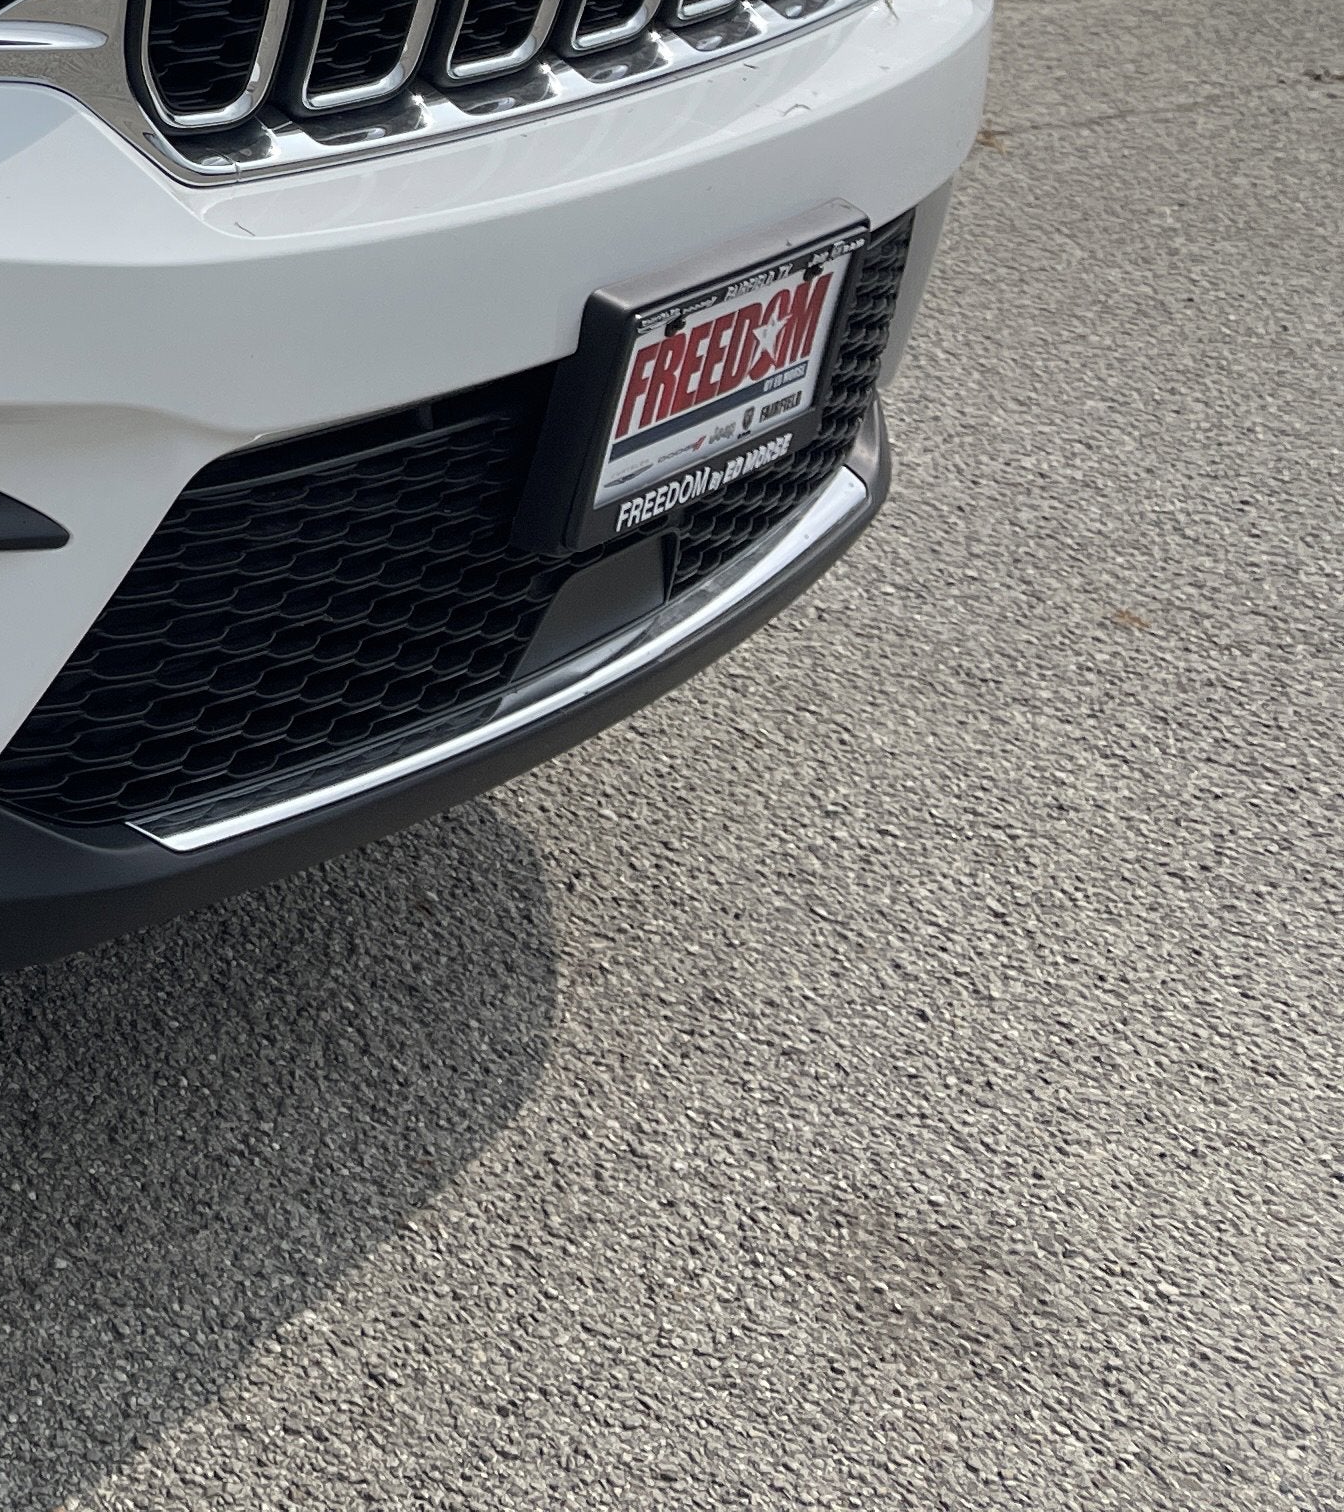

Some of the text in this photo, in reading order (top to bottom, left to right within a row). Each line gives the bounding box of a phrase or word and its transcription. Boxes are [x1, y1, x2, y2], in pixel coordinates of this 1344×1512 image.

[615, 272, 834, 441] FREEDOM
[615, 466, 712, 533] FREEDOM
[723, 456, 745, 485] ED
[742, 432, 794, 475] MORSE
